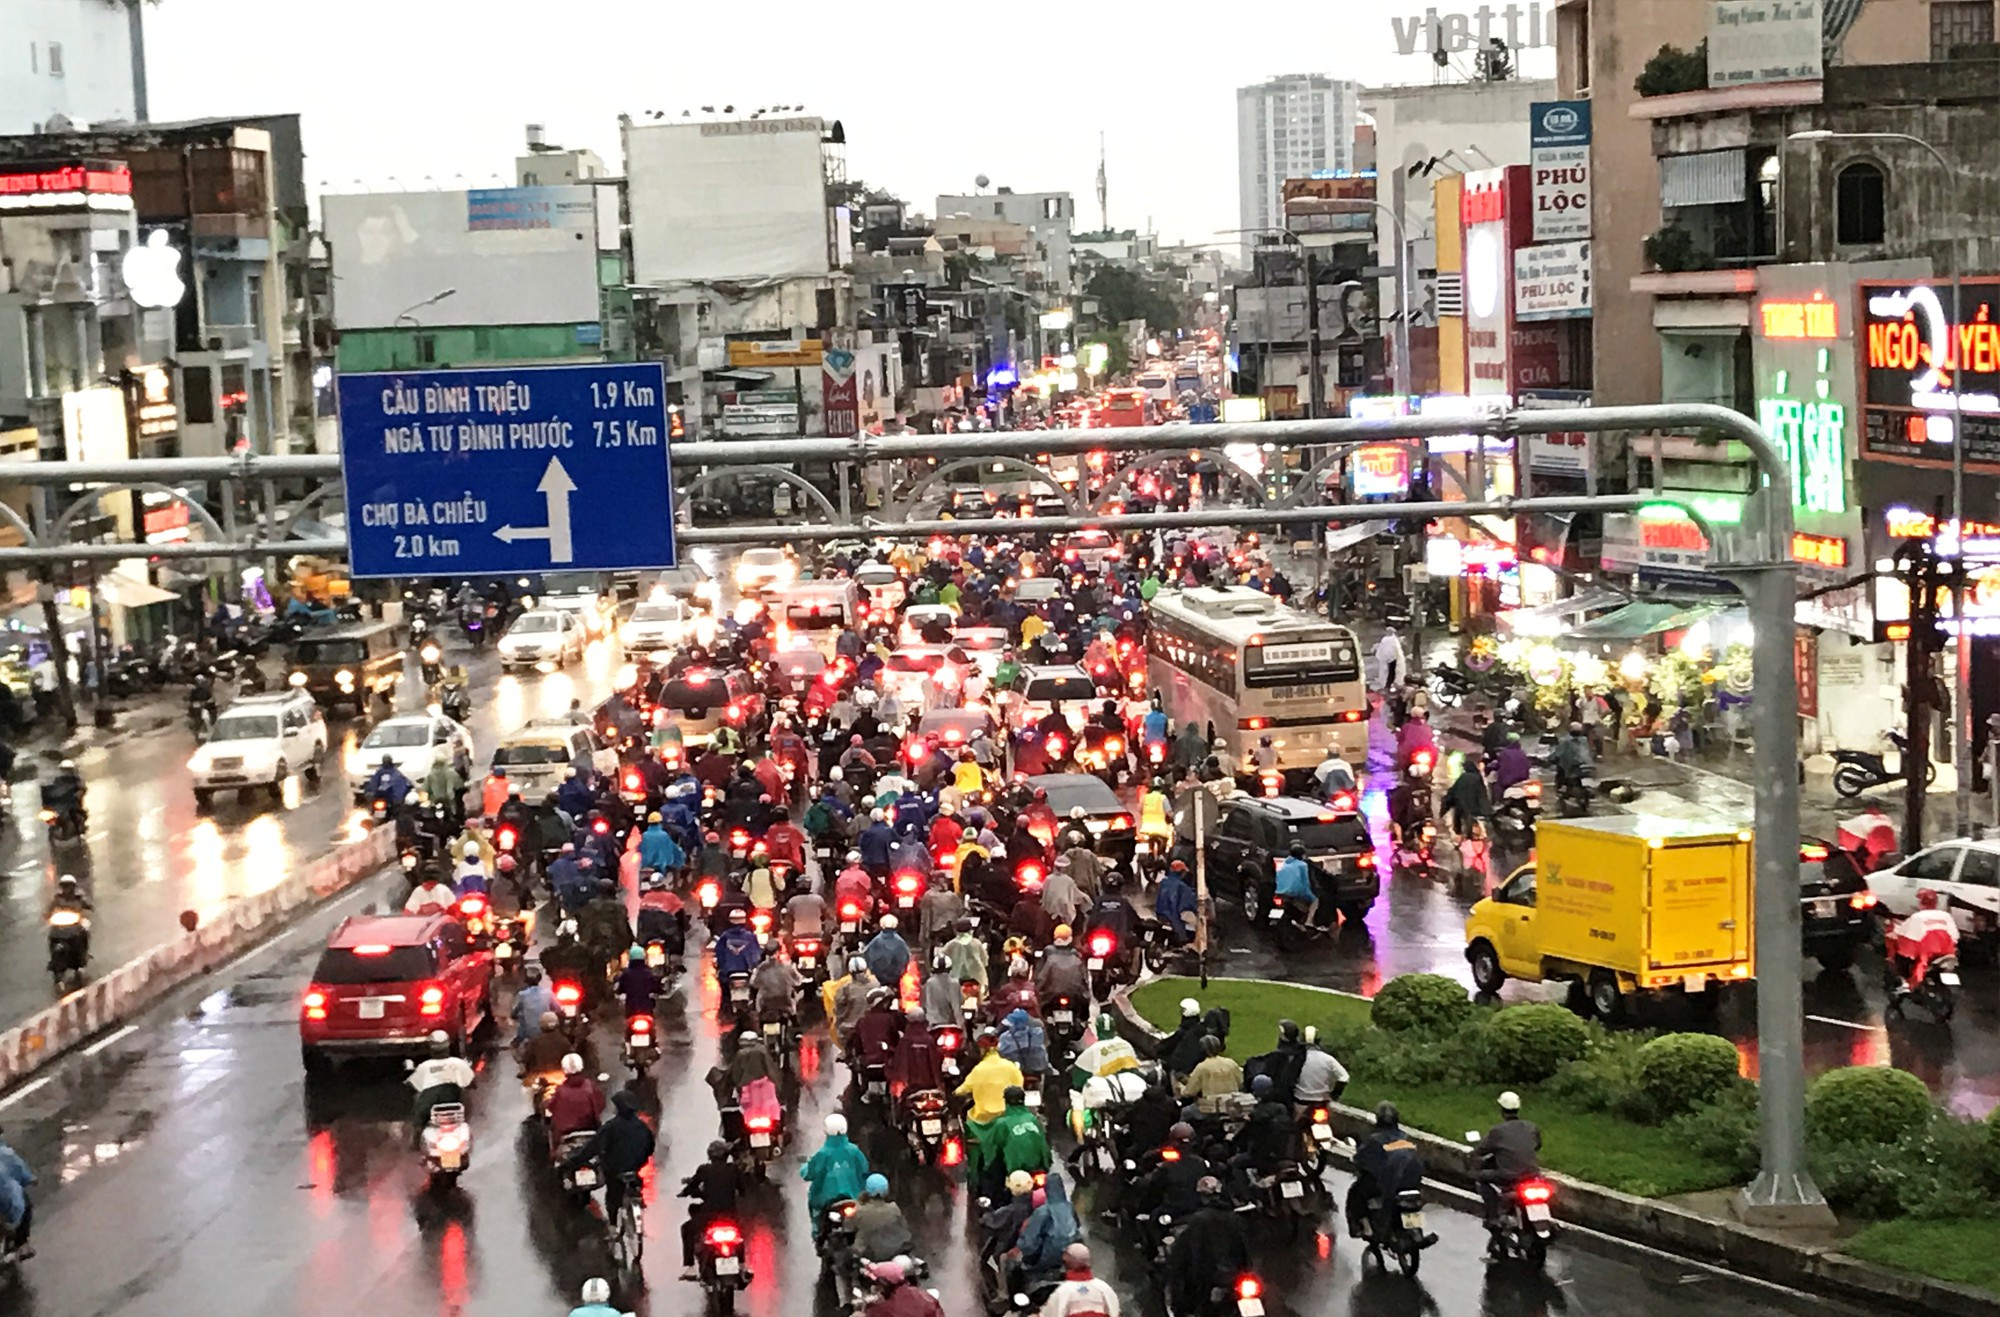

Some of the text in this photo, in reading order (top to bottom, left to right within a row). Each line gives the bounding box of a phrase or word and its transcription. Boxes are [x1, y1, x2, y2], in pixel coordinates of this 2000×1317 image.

[1536, 162, 1586, 186] PHÚ
[1538, 189, 1587, 214] LỘC
[1867, 309, 1919, 370] NGÔ
[382, 379, 419, 415] CẦU
[424, 381, 471, 414] BÌNH
[475, 380, 531, 416] TRIỆU
[623, 381, 655, 407] Km
[384, 415, 657, 454] NGÃ TƯ BÌNH PHƯỚC 7.5 Km
[362, 490, 487, 530] CHỢ BÀ CHIỂU
[428, 534, 460, 557] km
